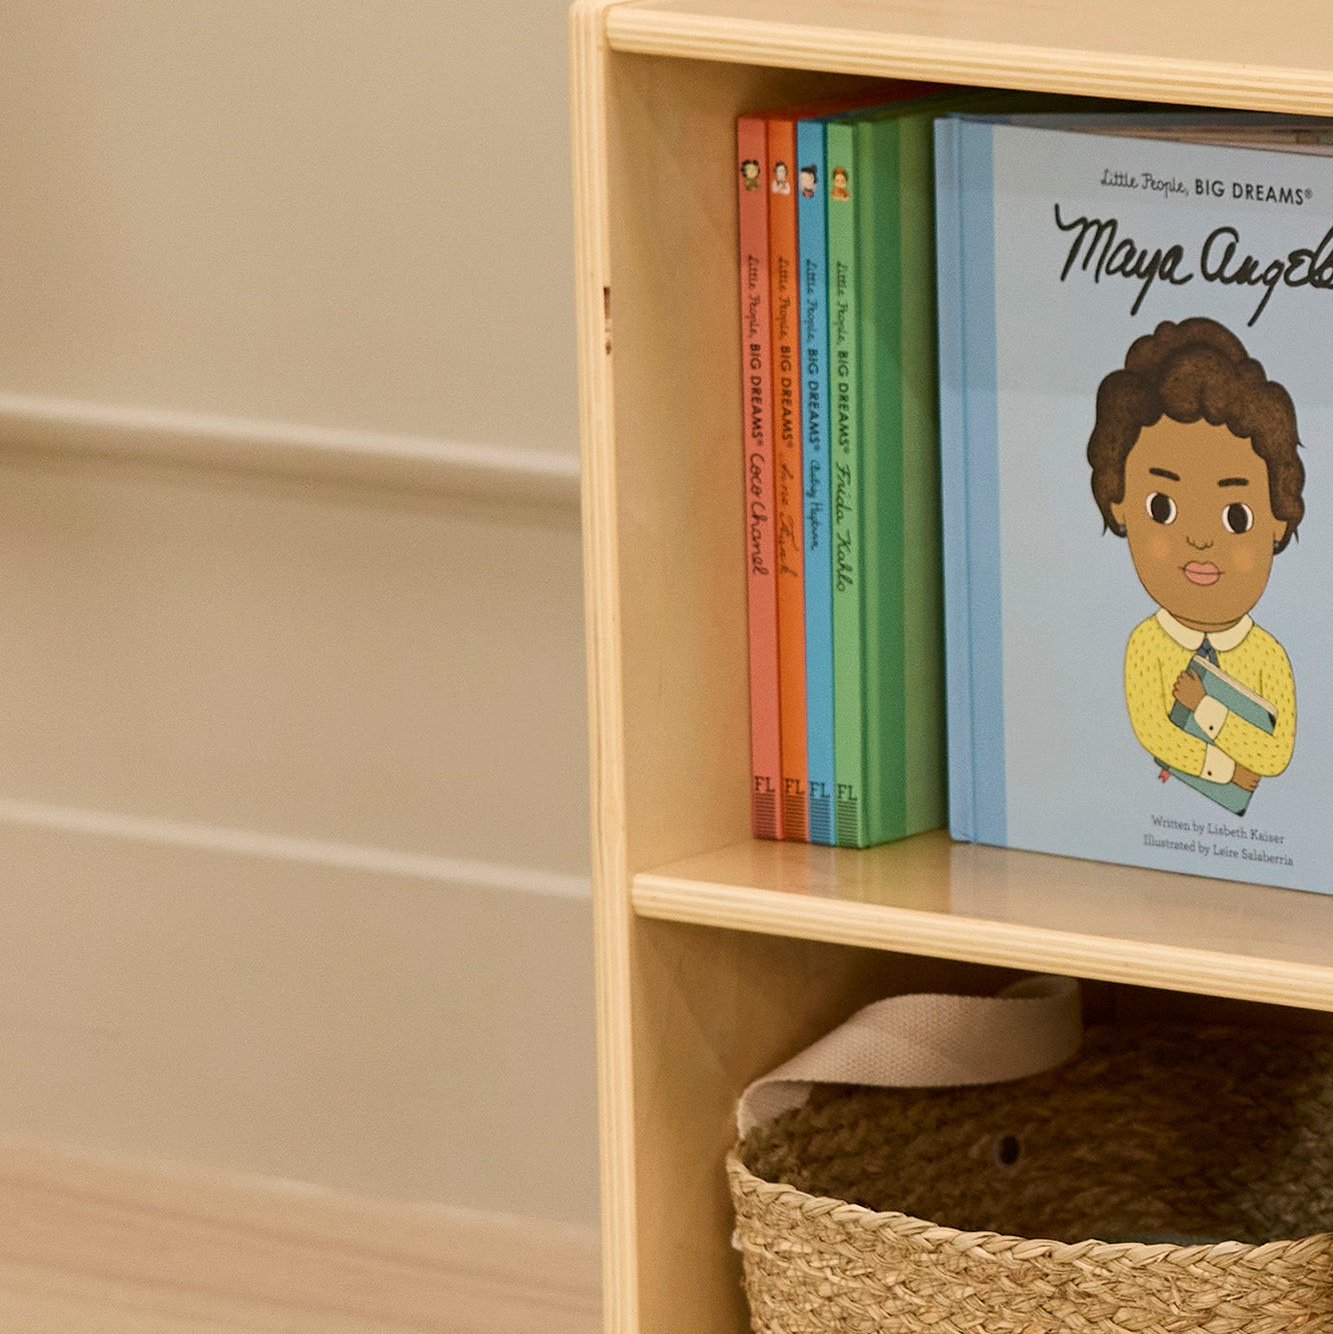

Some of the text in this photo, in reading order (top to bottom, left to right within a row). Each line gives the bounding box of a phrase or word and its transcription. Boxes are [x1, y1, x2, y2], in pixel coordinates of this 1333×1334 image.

[1101, 169, 1139, 188] Little
[1141, 172, 1190, 198] People,
[1195, 179, 1225, 198] BIG
[748, 255, 759, 289] Little
[778, 256, 789, 290] Little
[1054, 203, 1194, 316] Maya
[805, 259, 817, 293] Little
[837, 261, 848, 297] Little
[751, 344, 762, 370] BIG
[780, 346, 791, 372] BIG
[808, 349, 819, 375] BIG
[838, 351, 849, 377] BIG
[750, 453, 765, 496] Coco
[835, 462, 851, 525] Frida
[751, 501, 769, 575] Chanel
[837, 529, 854, 592] Kahlo
[755, 776, 775, 793] FL
[785, 778, 805, 795] FL
[809, 781, 830, 798] FL
[837, 783, 858, 801] FL
[1151, 815, 1284, 844] Written by Lisbeth Kaiser
[1143, 834, 1196, 852] Illustrated
[1198, 842, 1211, 856] by
[1213, 844, 1239, 858] Leire
